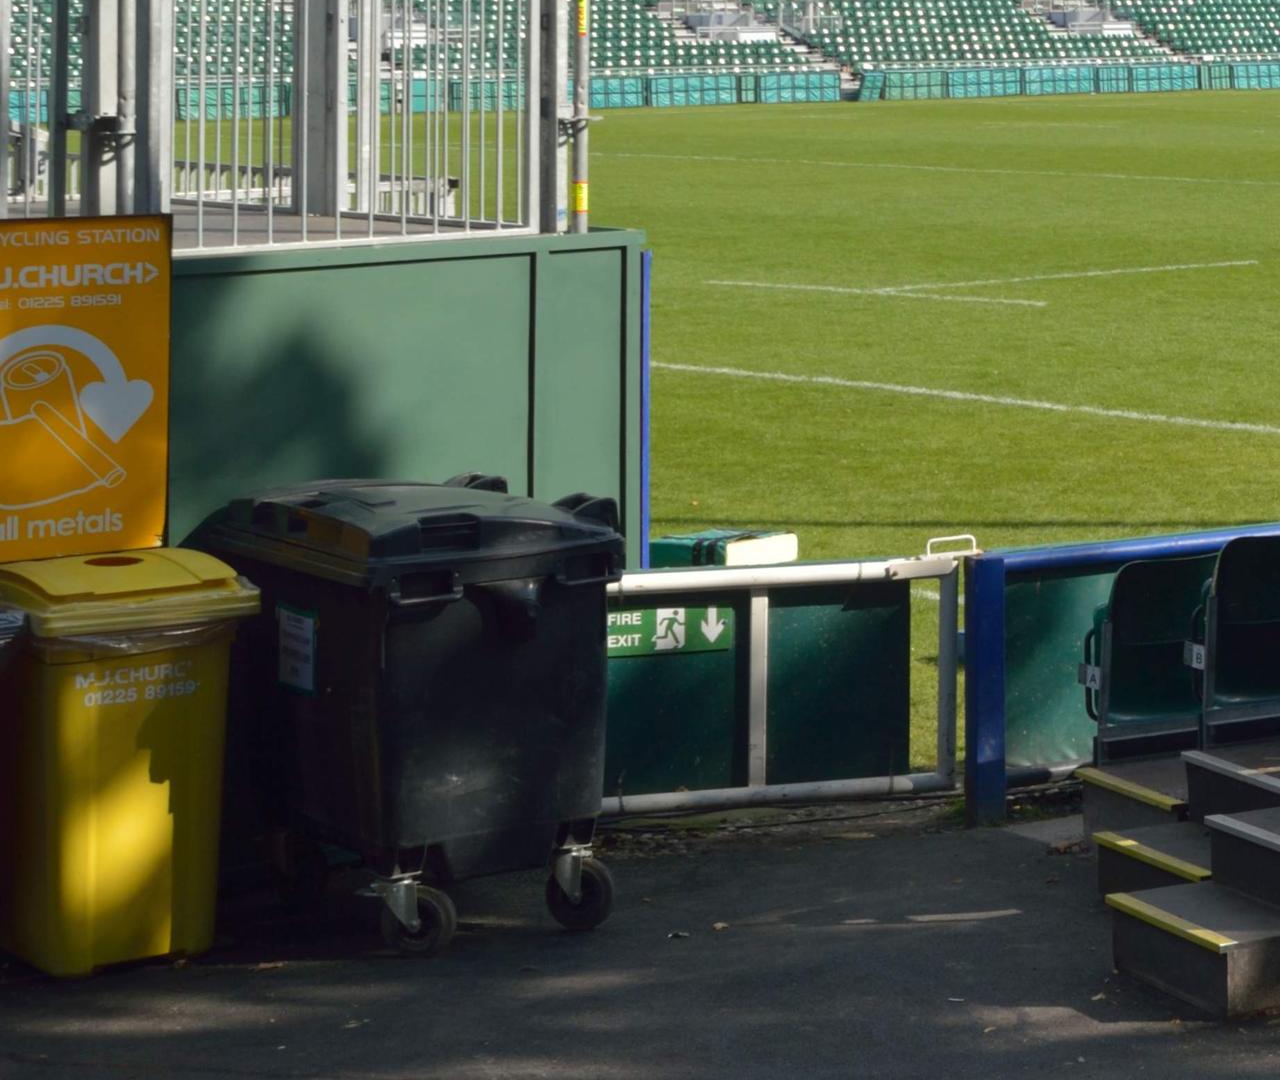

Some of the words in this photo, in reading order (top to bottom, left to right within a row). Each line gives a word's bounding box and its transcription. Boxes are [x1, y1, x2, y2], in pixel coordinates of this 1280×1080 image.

[77, 228, 160, 245] STATION
[18, 295, 65, 310] 01225
[27, 507, 123, 539] metals
[607, 612, 642, 626] FIRE
[607, 634, 642, 648] EXIT
[1195, 653, 1202, 664] B
[1089, 673, 1097, 684] A
[84, 688, 137, 708] 01225
[144, 680, 200, 700] 89159
